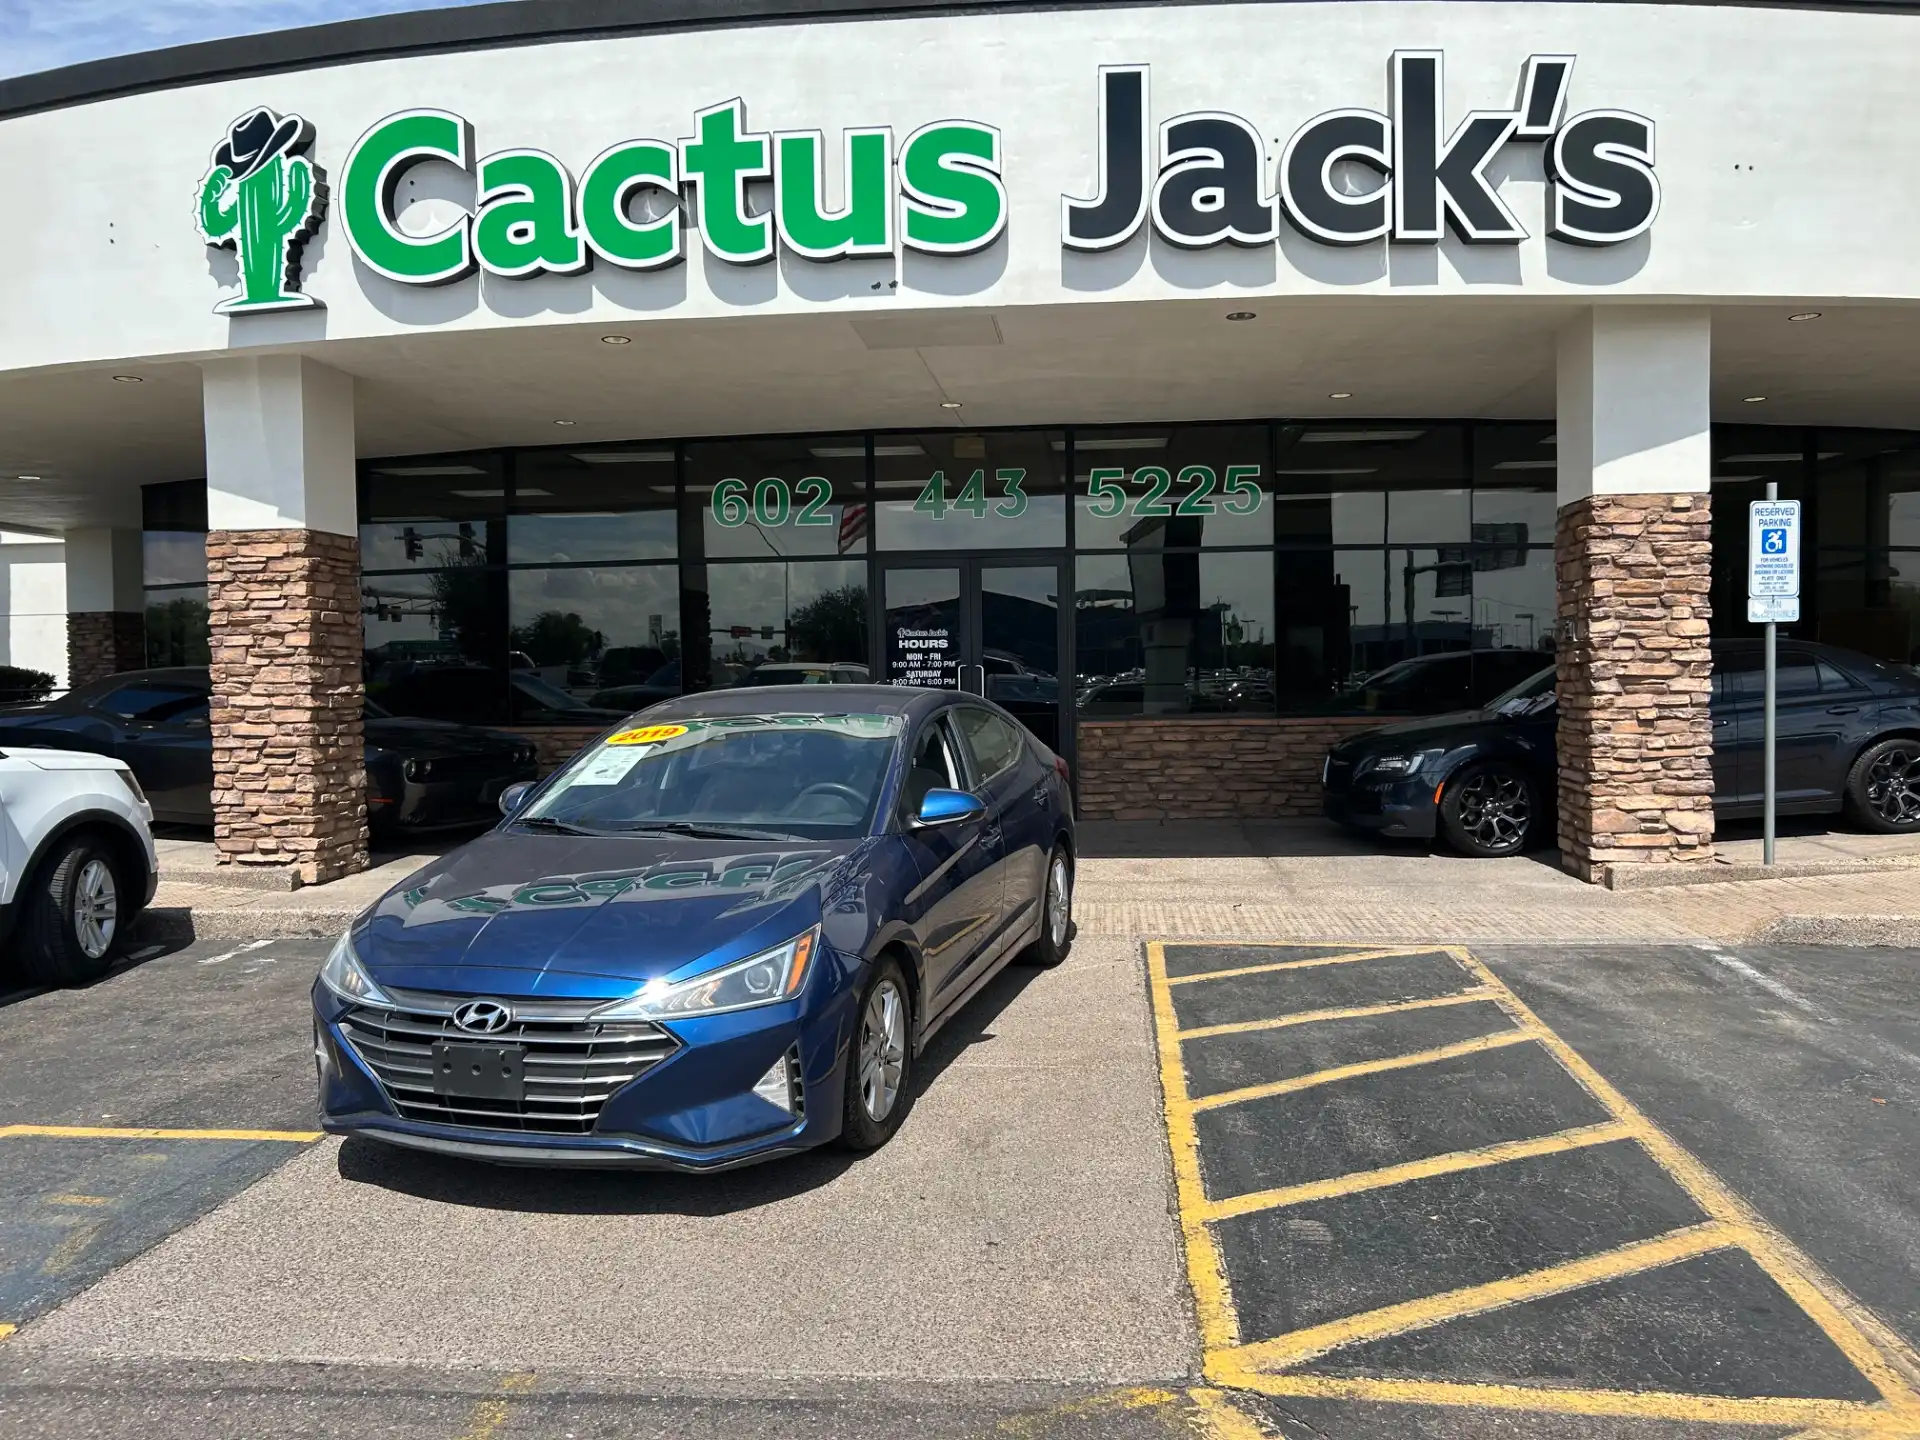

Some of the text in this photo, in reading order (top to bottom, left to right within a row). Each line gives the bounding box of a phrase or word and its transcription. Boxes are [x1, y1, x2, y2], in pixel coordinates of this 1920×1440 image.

[338, 49, 1661, 287] Cactus Jack's
[711, 464, 1263, 528] 602 443 5225
[1754, 507, 1795, 517] RESERVED
[1758, 518, 1792, 527] PARKING
[898, 639, 948, 649] HOURS
[906, 652, 923, 660] MON
[929, 652, 941, 660] FRI
[943, 660, 956, 668] PM
[906, 669, 941, 678] SATURDAY
[612, 727, 680, 742] 2019
